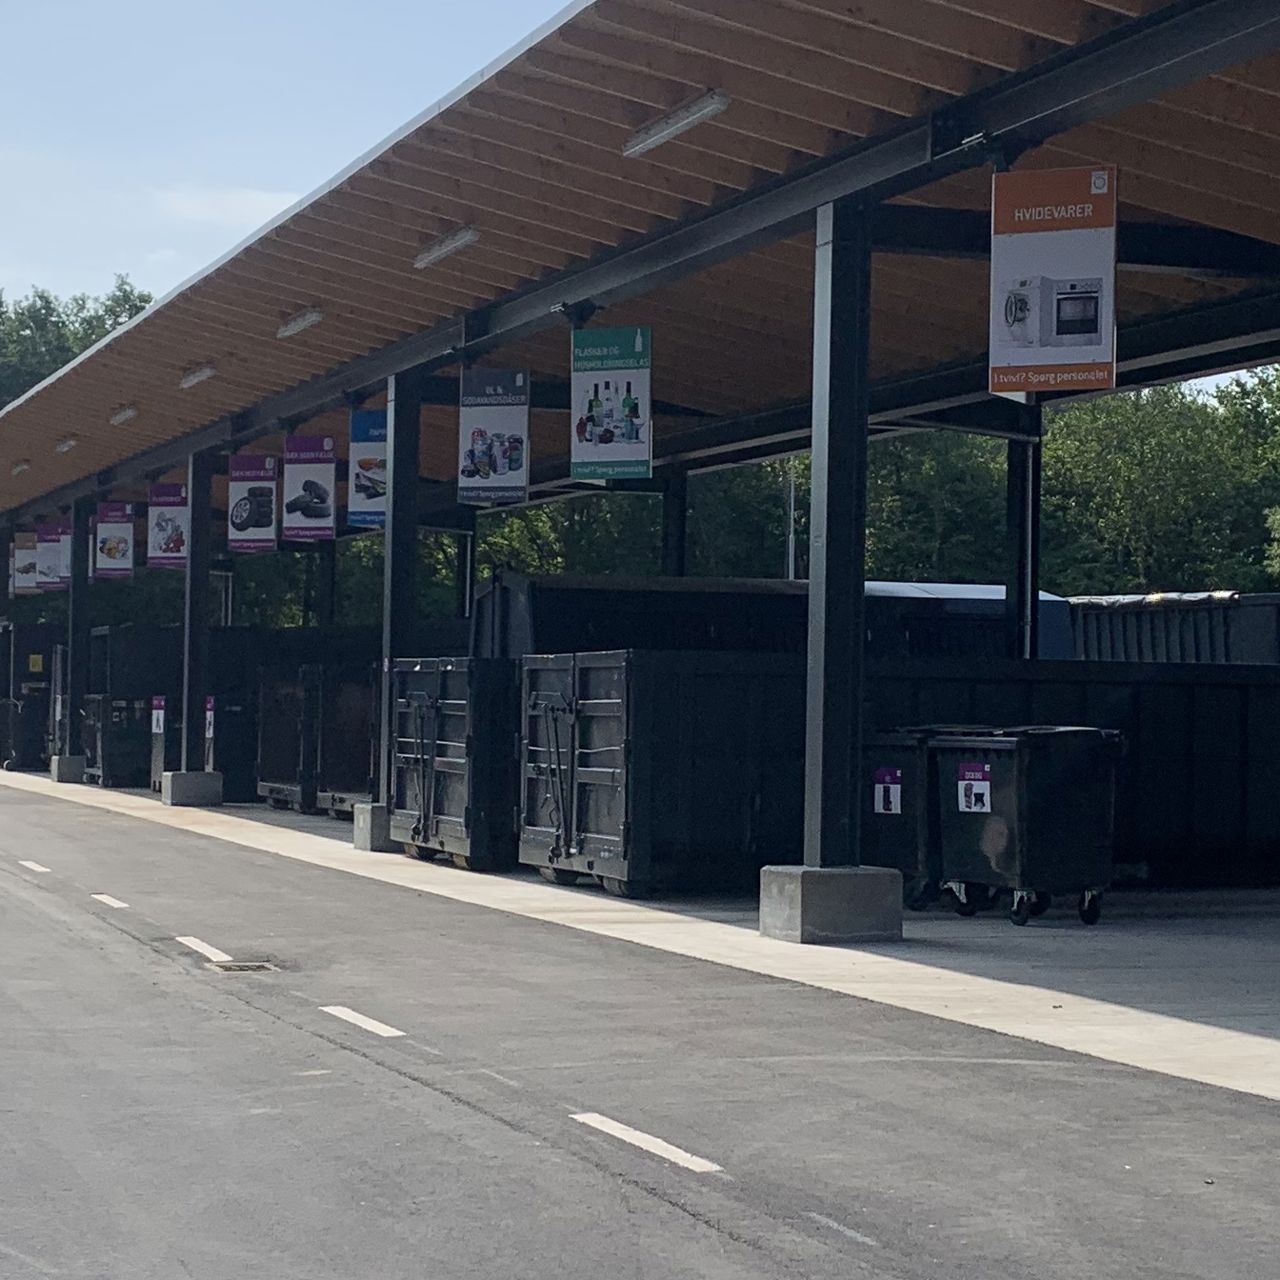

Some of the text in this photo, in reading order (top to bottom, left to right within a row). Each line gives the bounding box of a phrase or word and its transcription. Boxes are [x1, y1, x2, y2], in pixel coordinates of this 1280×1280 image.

[1014, 203, 1094, 221] HVIDEVARER
[1027, 371, 1056, 385] Spørg
[1057, 369, 1108, 383] personalet
